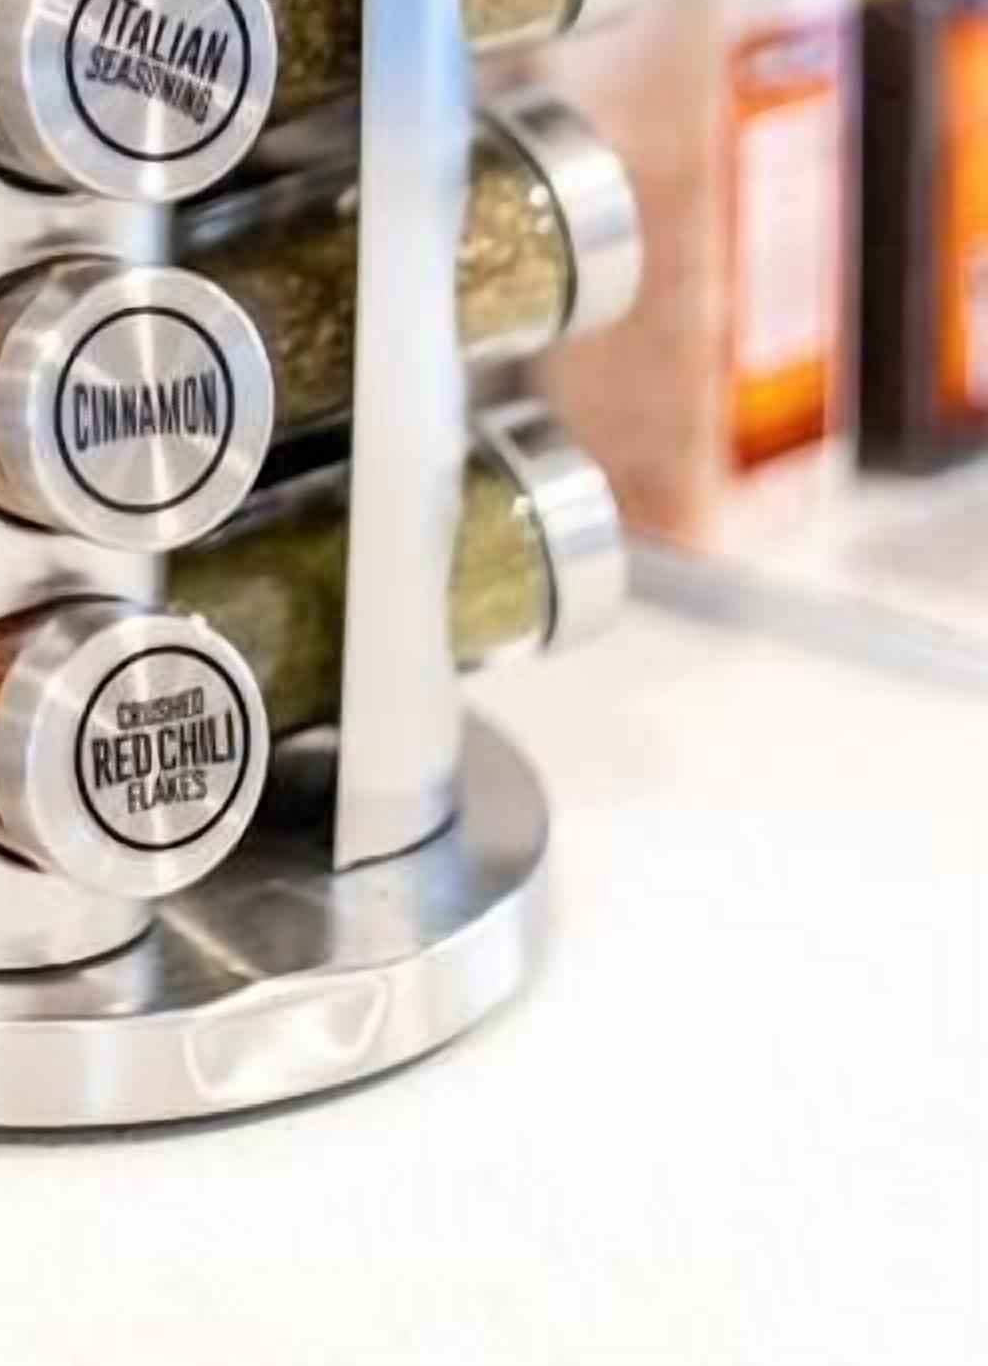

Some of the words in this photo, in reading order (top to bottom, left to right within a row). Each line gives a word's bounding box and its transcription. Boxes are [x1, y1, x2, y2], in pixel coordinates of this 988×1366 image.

[73, 370, 218, 452] CINNAMON
[91, 732, 153, 789] RED
[156, 707, 235, 771] CHILI
[127, 769, 208, 814] FLAKES
